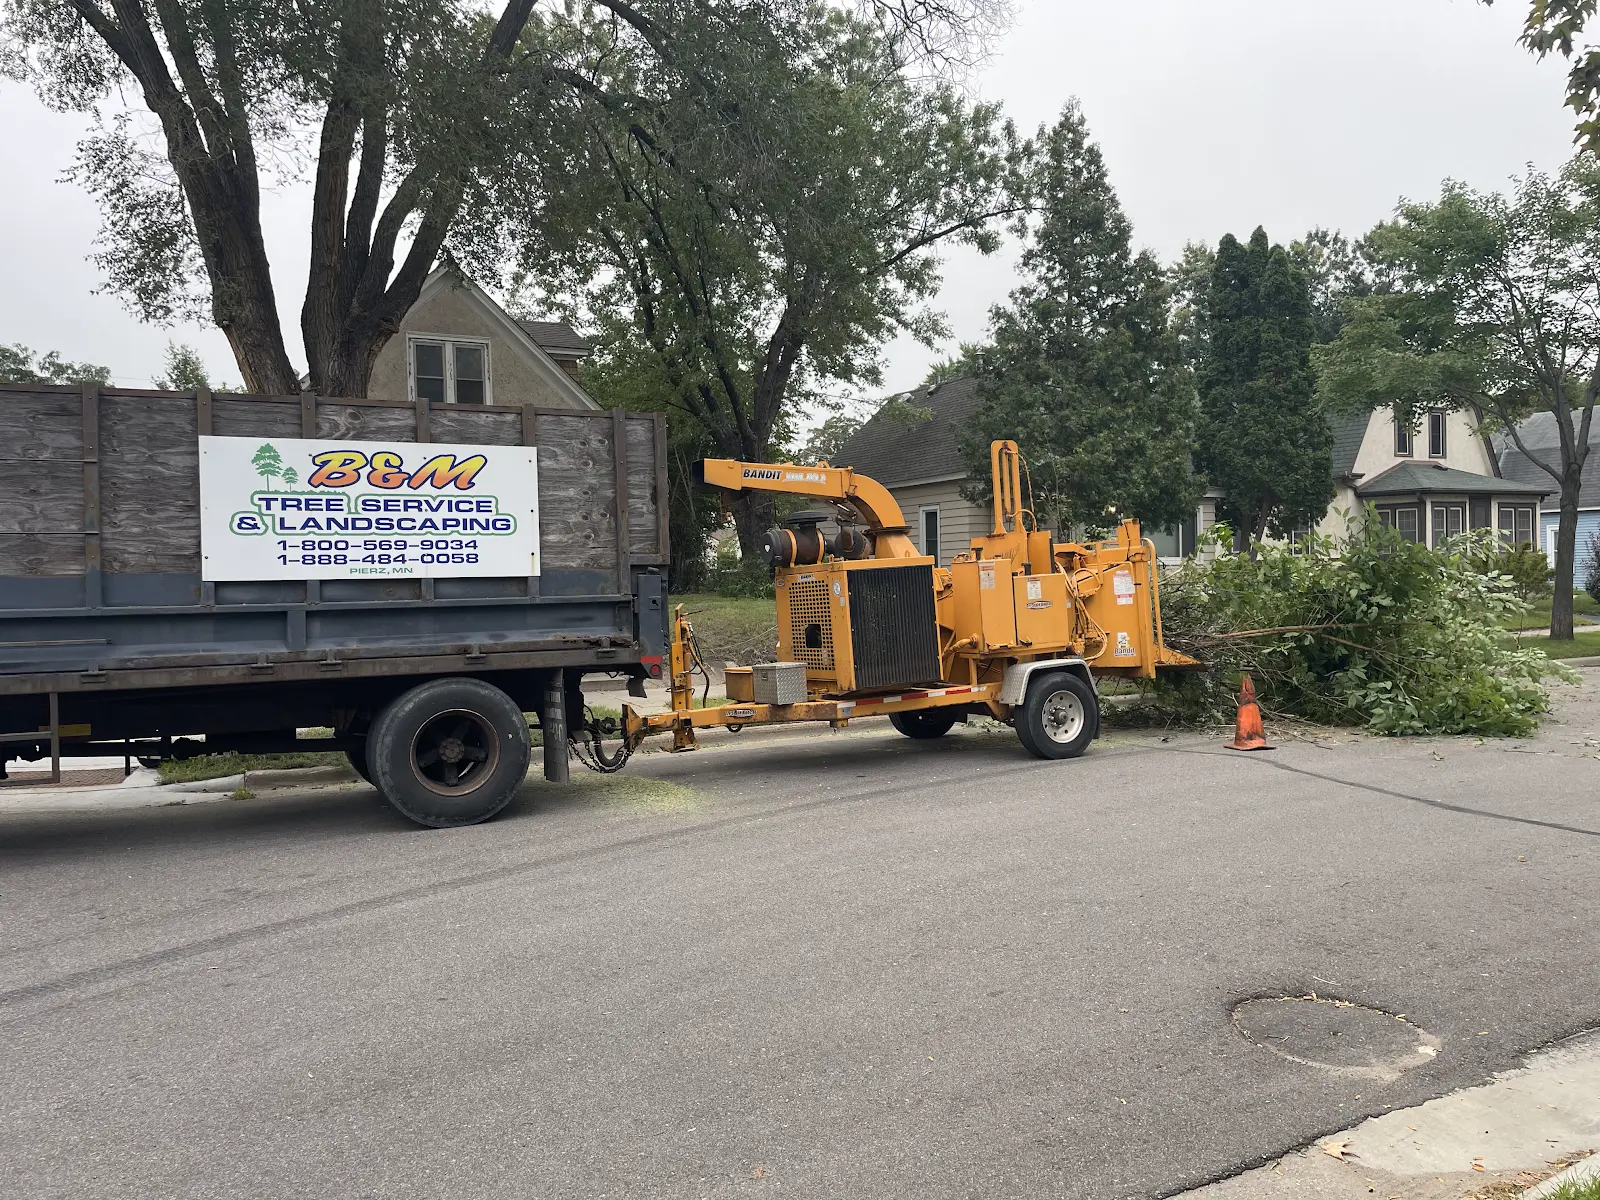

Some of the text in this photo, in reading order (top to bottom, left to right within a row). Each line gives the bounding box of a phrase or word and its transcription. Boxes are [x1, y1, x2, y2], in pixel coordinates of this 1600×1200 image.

[308, 450, 487, 490] B&M
[743, 469, 782, 479] BANDIT
[258, 497, 492, 512] TREE SERVICE
[236, 516, 511, 531] & LANDSCAPING
[277, 539, 478, 551] 1-800-569-9034
[277, 553, 479, 566] 1-888-484-0058
[350, 567, 390, 575] PIERZ,
